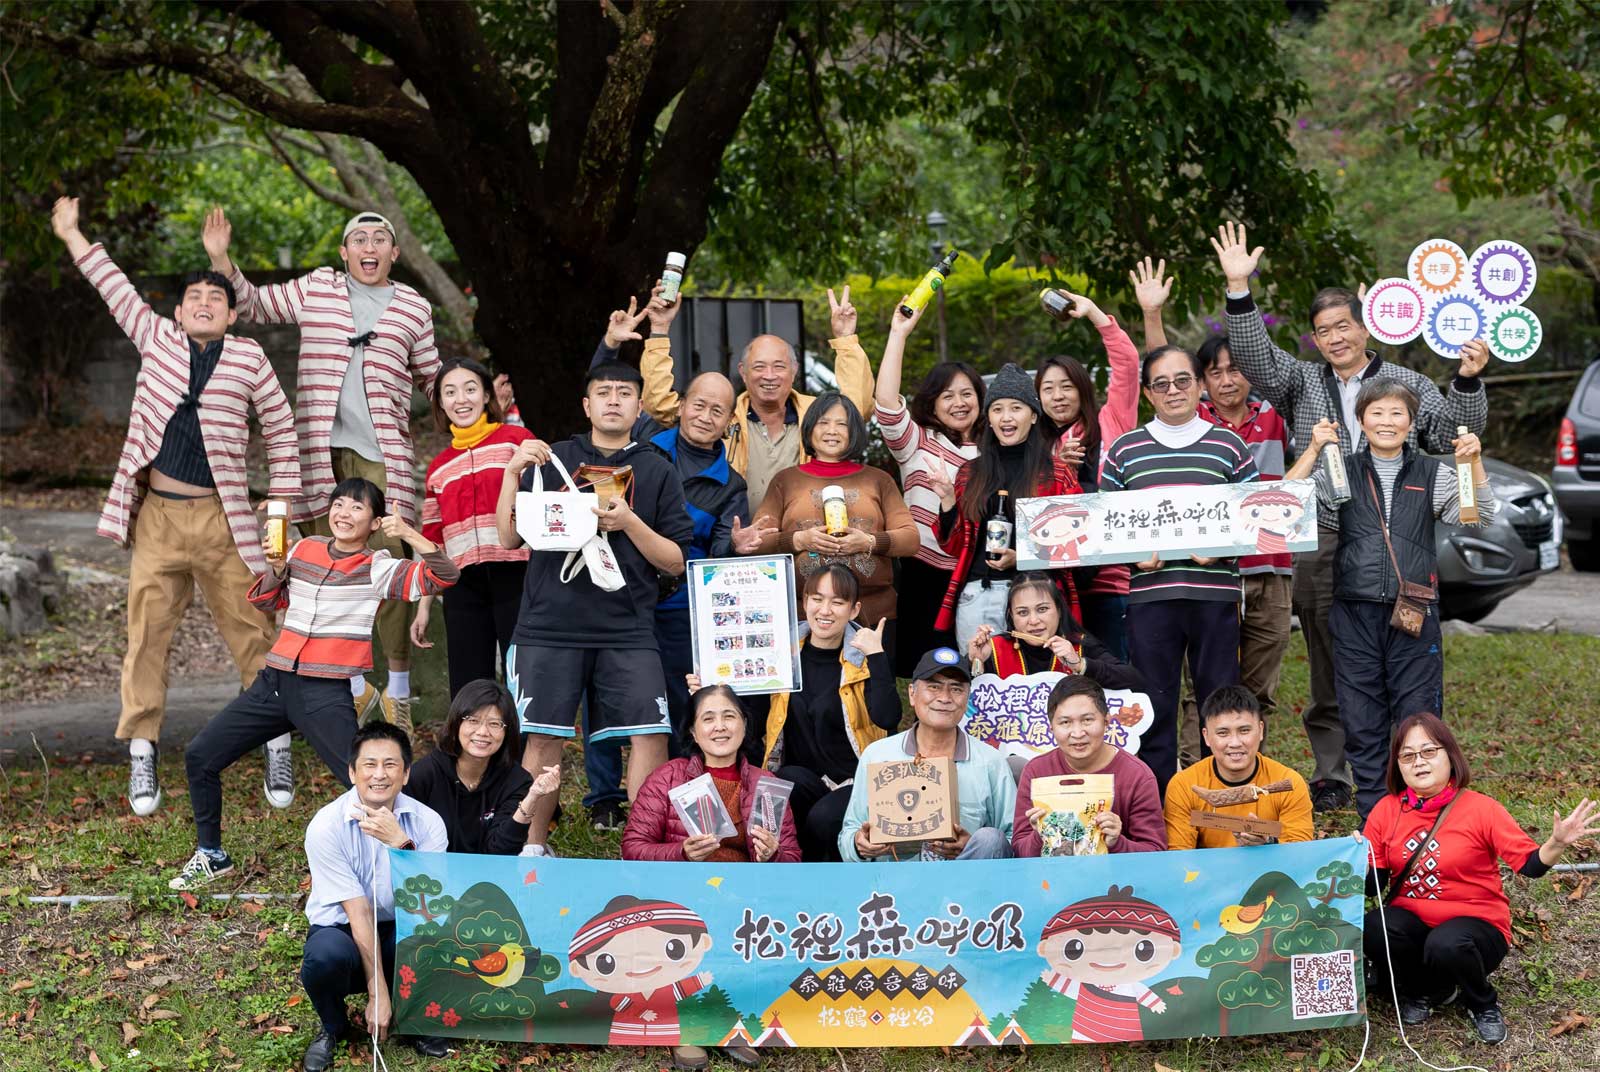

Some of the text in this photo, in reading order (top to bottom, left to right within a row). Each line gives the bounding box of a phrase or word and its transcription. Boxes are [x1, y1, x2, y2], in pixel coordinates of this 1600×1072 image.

[1427, 263, 1451, 275] 共享
[1487, 267, 1517, 282] 共創
[1379, 301, 1415, 320] 共識
[1441, 316, 1473, 332] 共工
[1501, 327, 1527, 340] 共榮
[1102, 498, 1231, 530] 松裡森呼吸
[903, 793, 914, 807] 8
[733, 892, 1026, 962] 松裡森呼吸
[799, 971, 959, 994] 泰雅原音舞味
